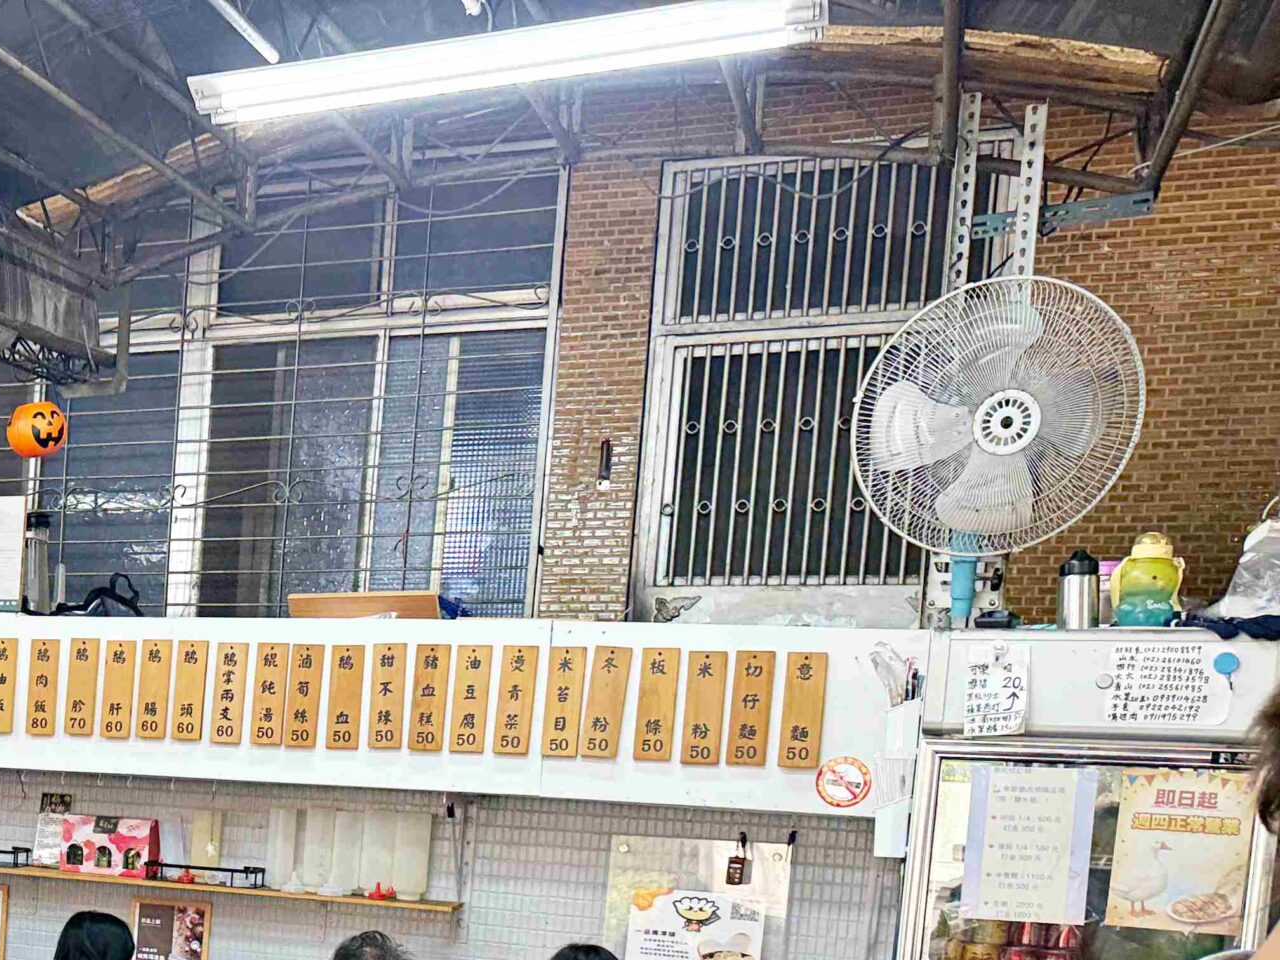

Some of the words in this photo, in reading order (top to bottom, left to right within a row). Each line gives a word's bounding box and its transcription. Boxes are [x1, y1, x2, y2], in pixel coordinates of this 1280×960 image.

[34, 648, 50, 713] 鵝肉飯
[108, 651, 126, 716] 鵝肝
[144, 648, 162, 717] 鵝腸
[180, 650, 198, 717] 鵝頭
[218, 652, 237, 721] 鵝掌兩支
[259, 653, 278, 722] 餛飩湯
[334, 655, 354, 724] 鵝血
[377, 654, 395, 726] 甜不辣
[418, 655, 438, 726] 豬血糕
[460, 656, 481, 730] 油豆腐
[504, 655, 526, 730] 燙青菜
[554, 656, 573, 731] 米苔目
[591, 657, 618, 732] 冬粉
[645, 658, 667, 735] 板條
[691, 662, 714, 740] 米粉
[738, 662, 762, 740] 切仔麵
[790, 663, 813, 742] 意麵
[32, 718, 48, 728] 80
[70, 718, 86, 729] 70
[106, 721, 123, 732] 60
[142, 720, 158, 732] 60
[177, 722, 194, 733] 60
[217, 726, 234, 737] 60
[256, 727, 274, 738] 50
[291, 730, 309, 742] 50
[332, 730, 351, 742] 50
[375, 730, 394, 742] 50
[416, 732, 434, 744] 50
[456, 733, 476, 746] 50
[500, 736, 520, 748] 50
[550, 738, 568, 751] 50
[587, 738, 608, 751] 50
[642, 739, 663, 752] 50
[690, 746, 710, 759] 50
[734, 746, 757, 759] 50
[786, 748, 809, 760] 50
[1154, 789, 1218, 809] 即日起
[1132, 812, 1241, 836] 週四正常營業
